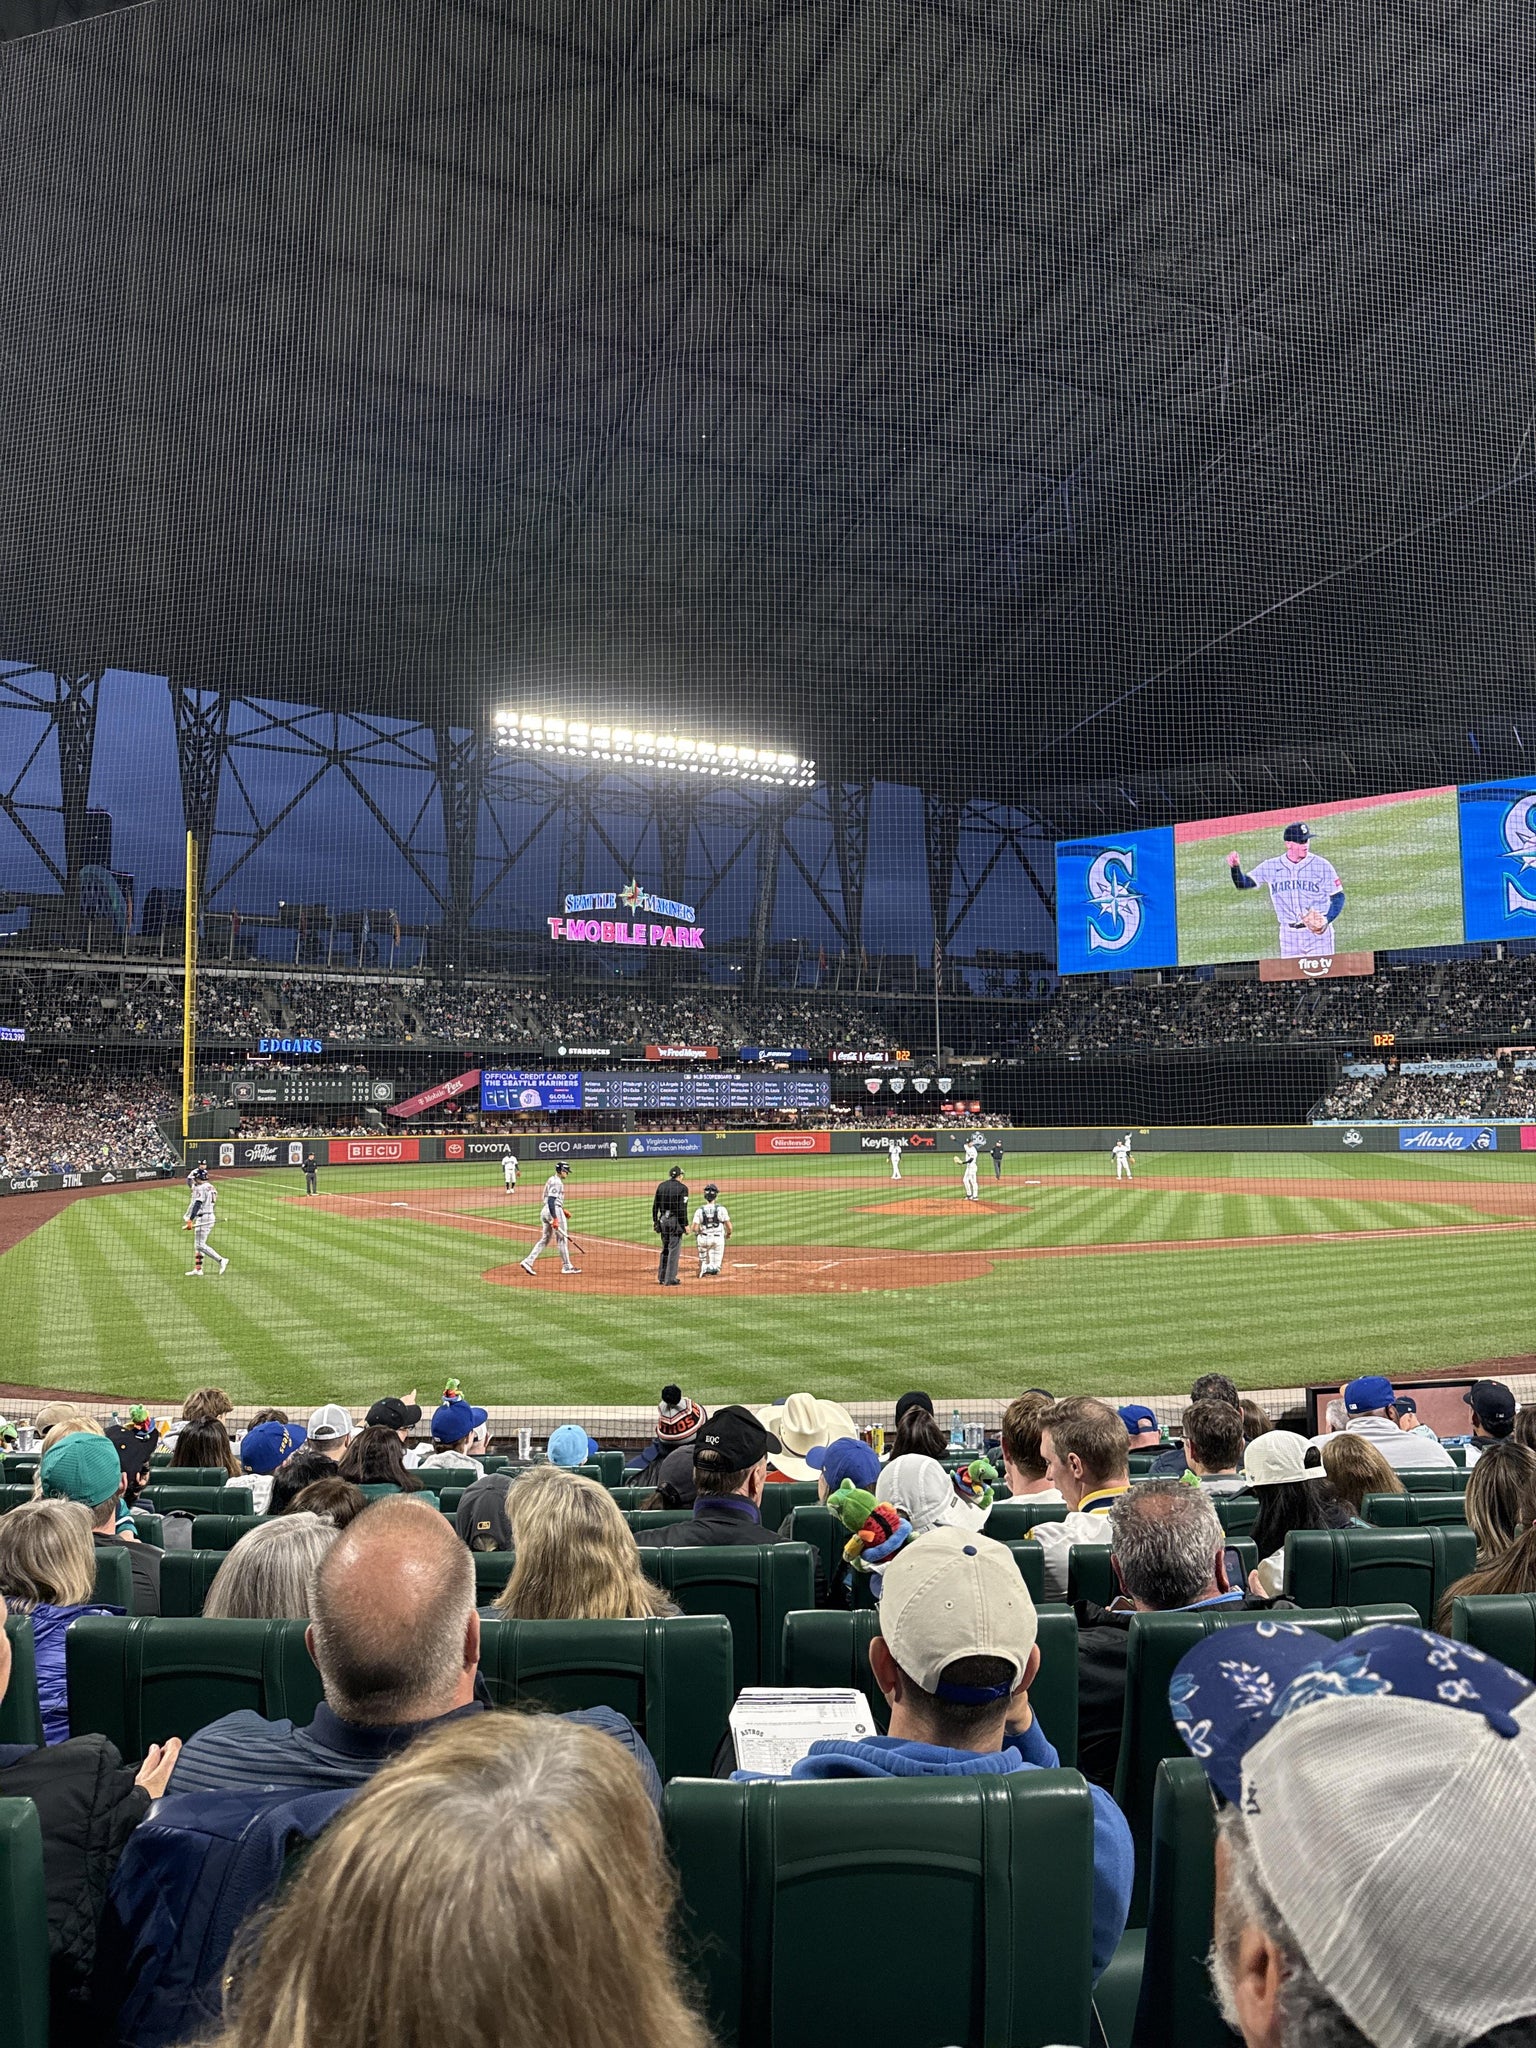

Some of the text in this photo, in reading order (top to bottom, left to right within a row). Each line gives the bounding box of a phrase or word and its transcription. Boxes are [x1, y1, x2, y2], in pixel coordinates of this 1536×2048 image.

[1271, 880, 1320, 895] MARINERS
[565, 892, 696, 923] SEATTLE MARINERS
[547, 917, 705, 948] T-MOBILE PARK
[1299, 957, 1332, 969] fire tv
[1373, 1033, 1395, 1046] 0:22
[424, 1089, 446, 1103] Mobile
[646, 1137, 667, 1145] Virginia
[1346, 1132, 1359, 1140] 50
[1404, 1130, 1463, 1147] Alaska
[468, 1144, 511, 1153] TOYOTA
[539, 1141, 570, 1152] eero
[774, 1139, 812, 1147] Nintendo
[861, 1137, 908, 1149] KeyBank
[10, 1177, 39, 1191] Great Clips
[62, 1174, 83, 1188] STIHL
[705, 1435, 720, 1446] EQC
[741, 1728, 764, 1737] ASTROS
